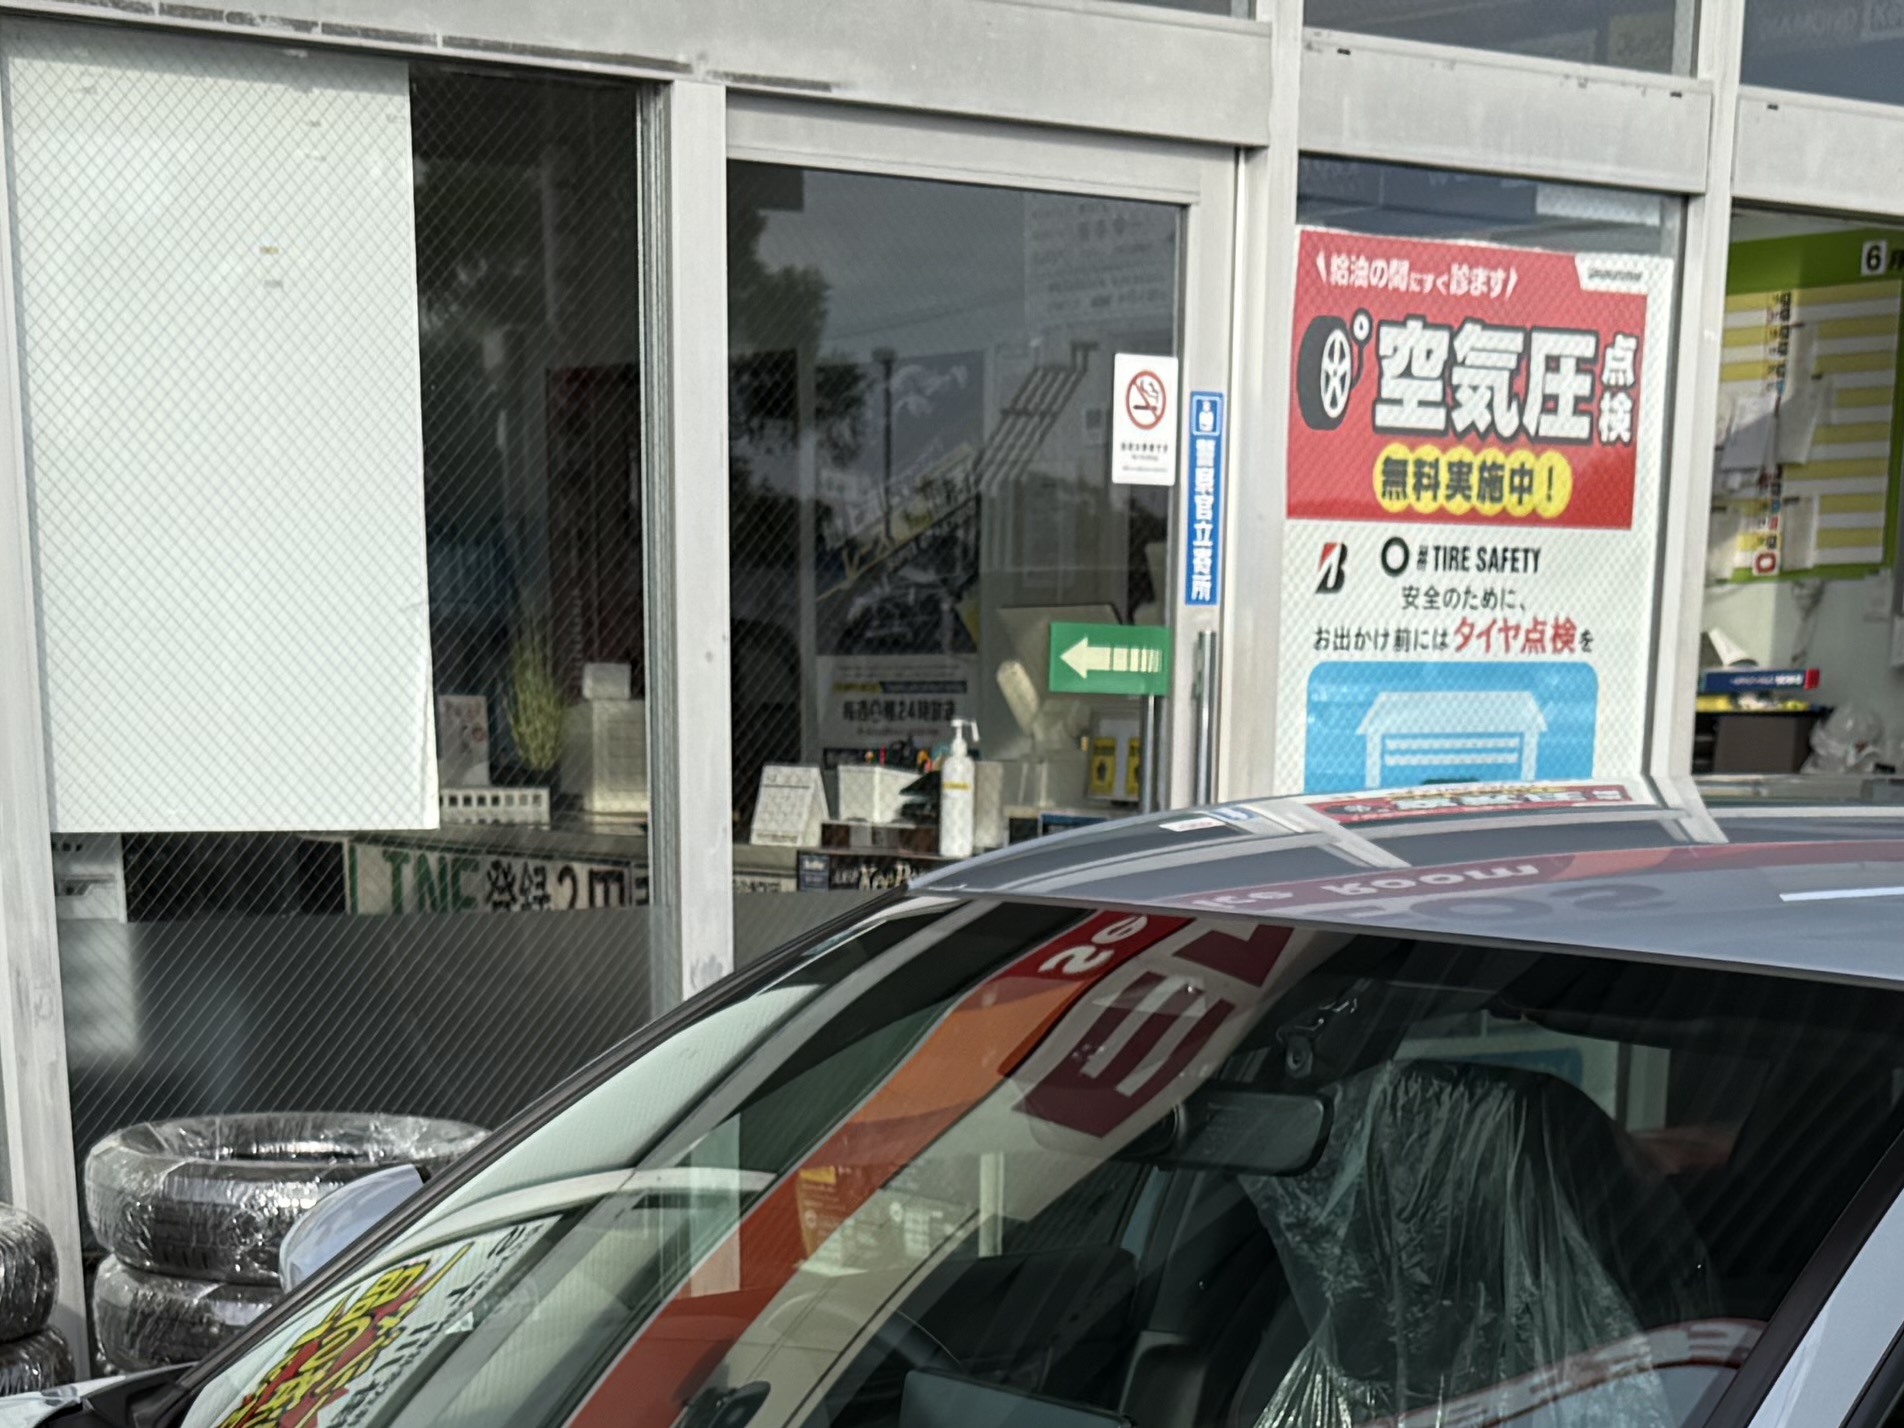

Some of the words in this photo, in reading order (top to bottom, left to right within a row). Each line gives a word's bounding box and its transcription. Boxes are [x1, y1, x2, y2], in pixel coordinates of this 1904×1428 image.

[1865, 245, 1882, 272] 6
[1373, 314, 1600, 443] 空気圧
[1598, 333, 1638, 446] 点検
[1434, 545, 1470, 574] TIRE
[1476, 546, 1541, 575] SAFETY
